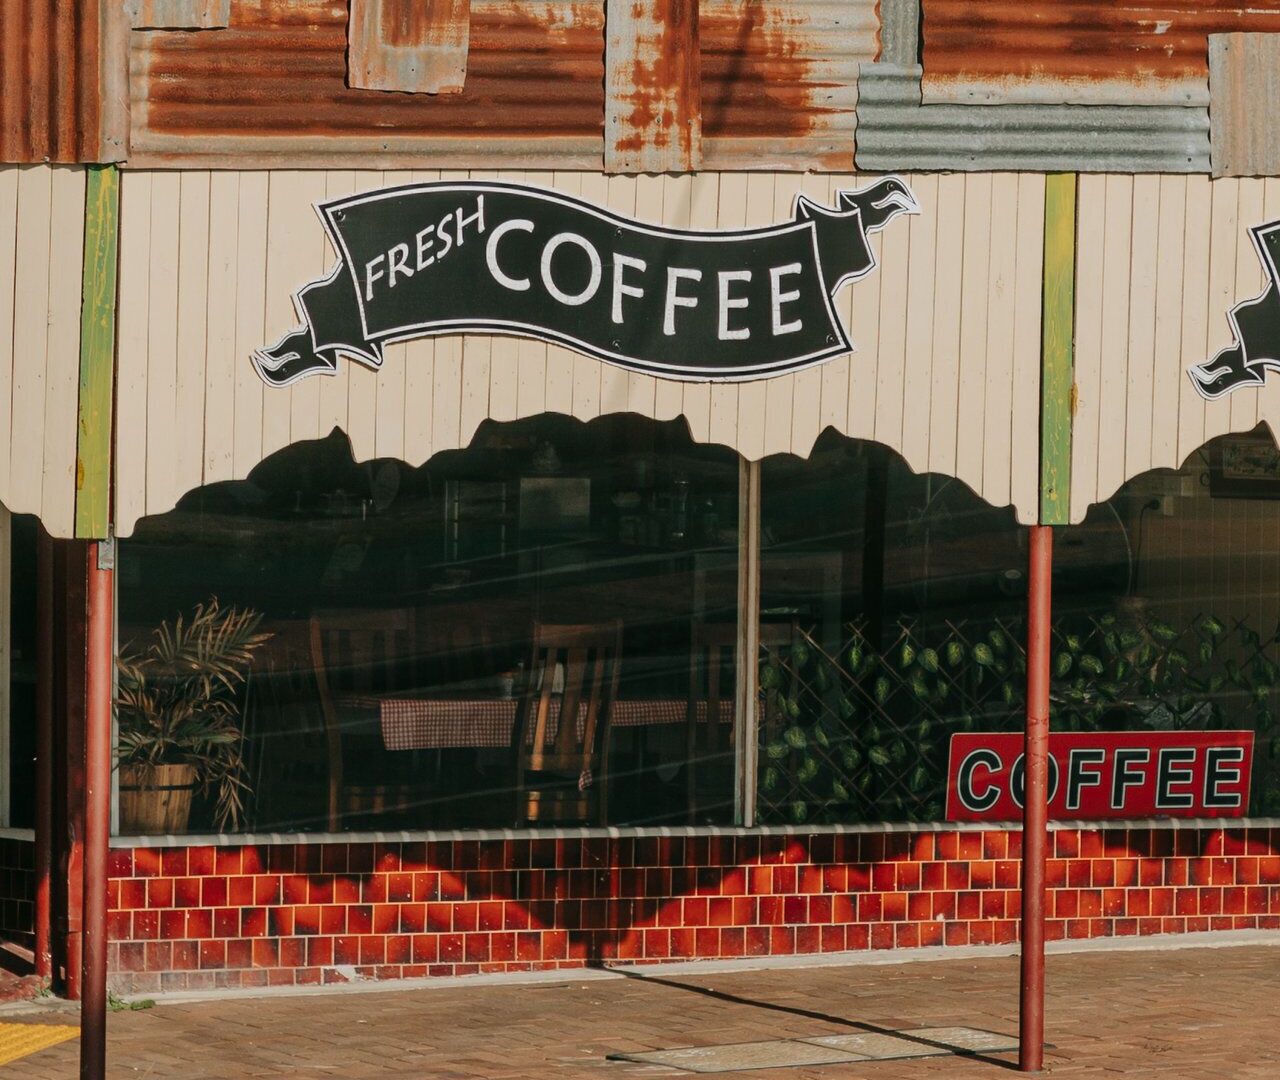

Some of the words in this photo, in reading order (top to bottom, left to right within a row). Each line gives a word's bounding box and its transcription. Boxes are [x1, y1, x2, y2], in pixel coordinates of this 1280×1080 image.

[364, 194, 486, 302] FRESH
[485, 219, 803, 341] COFFEE
[956, 747, 1244, 813] COFFEE
